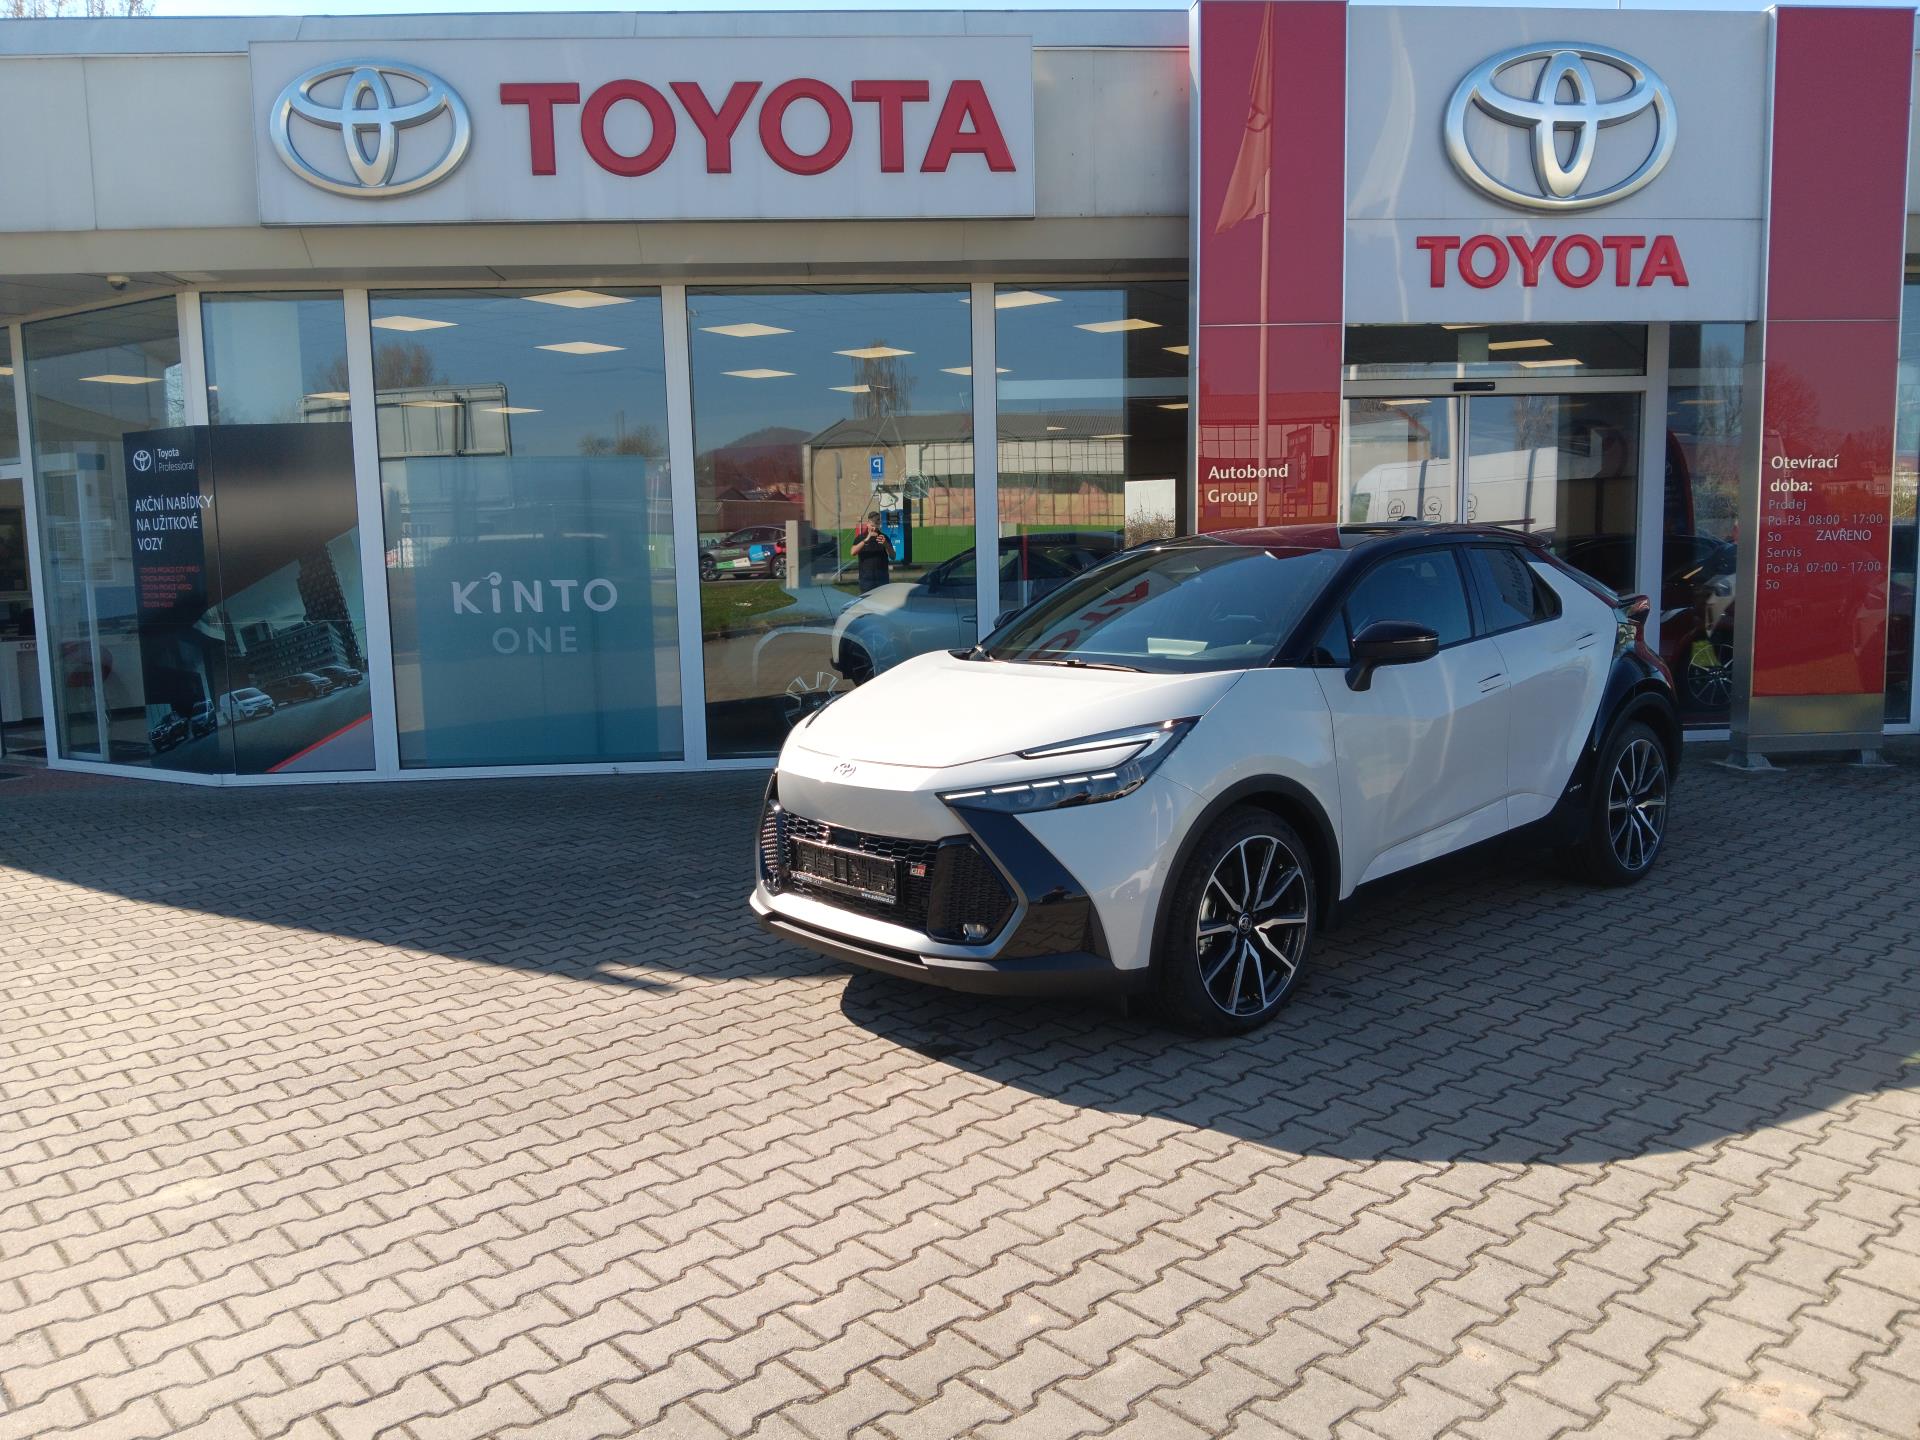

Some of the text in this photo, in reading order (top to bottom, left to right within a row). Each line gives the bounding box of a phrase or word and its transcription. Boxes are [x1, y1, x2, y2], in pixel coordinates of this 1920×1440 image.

[499, 78, 1017, 177] TOYOTA
[1416, 233, 1689, 289] TOYOTA
[156, 448, 180, 460] Toyota
[1771, 454, 1840, 469] Otevírací
[1208, 464, 1289, 480] Autobond
[1770, 478, 1813, 492] doba:
[135, 492, 213, 512] AKČNÍ NABÍDKY
[1208, 489, 1258, 506] Group
[1768, 500, 1807, 511] Prodej
[136, 512, 199, 532] NA UŽITKOVÉ
[1768, 515, 1801, 526] Po-Pá
[1808, 514, 1840, 525] 08:00
[1853, 513, 1883, 524] 17:00
[1767, 528, 1872, 542] So ZAVŘENO
[138, 537, 163, 551] VOZY
[1767, 547, 1802, 558] Servis
[1766, 563, 1799, 574] Po-Pá
[1806, 562, 1838, 573] 07:00
[1851, 561, 1881, 572] 17:00
[1766, 579, 1780, 590] So
[492, 626, 579, 654] ONE
